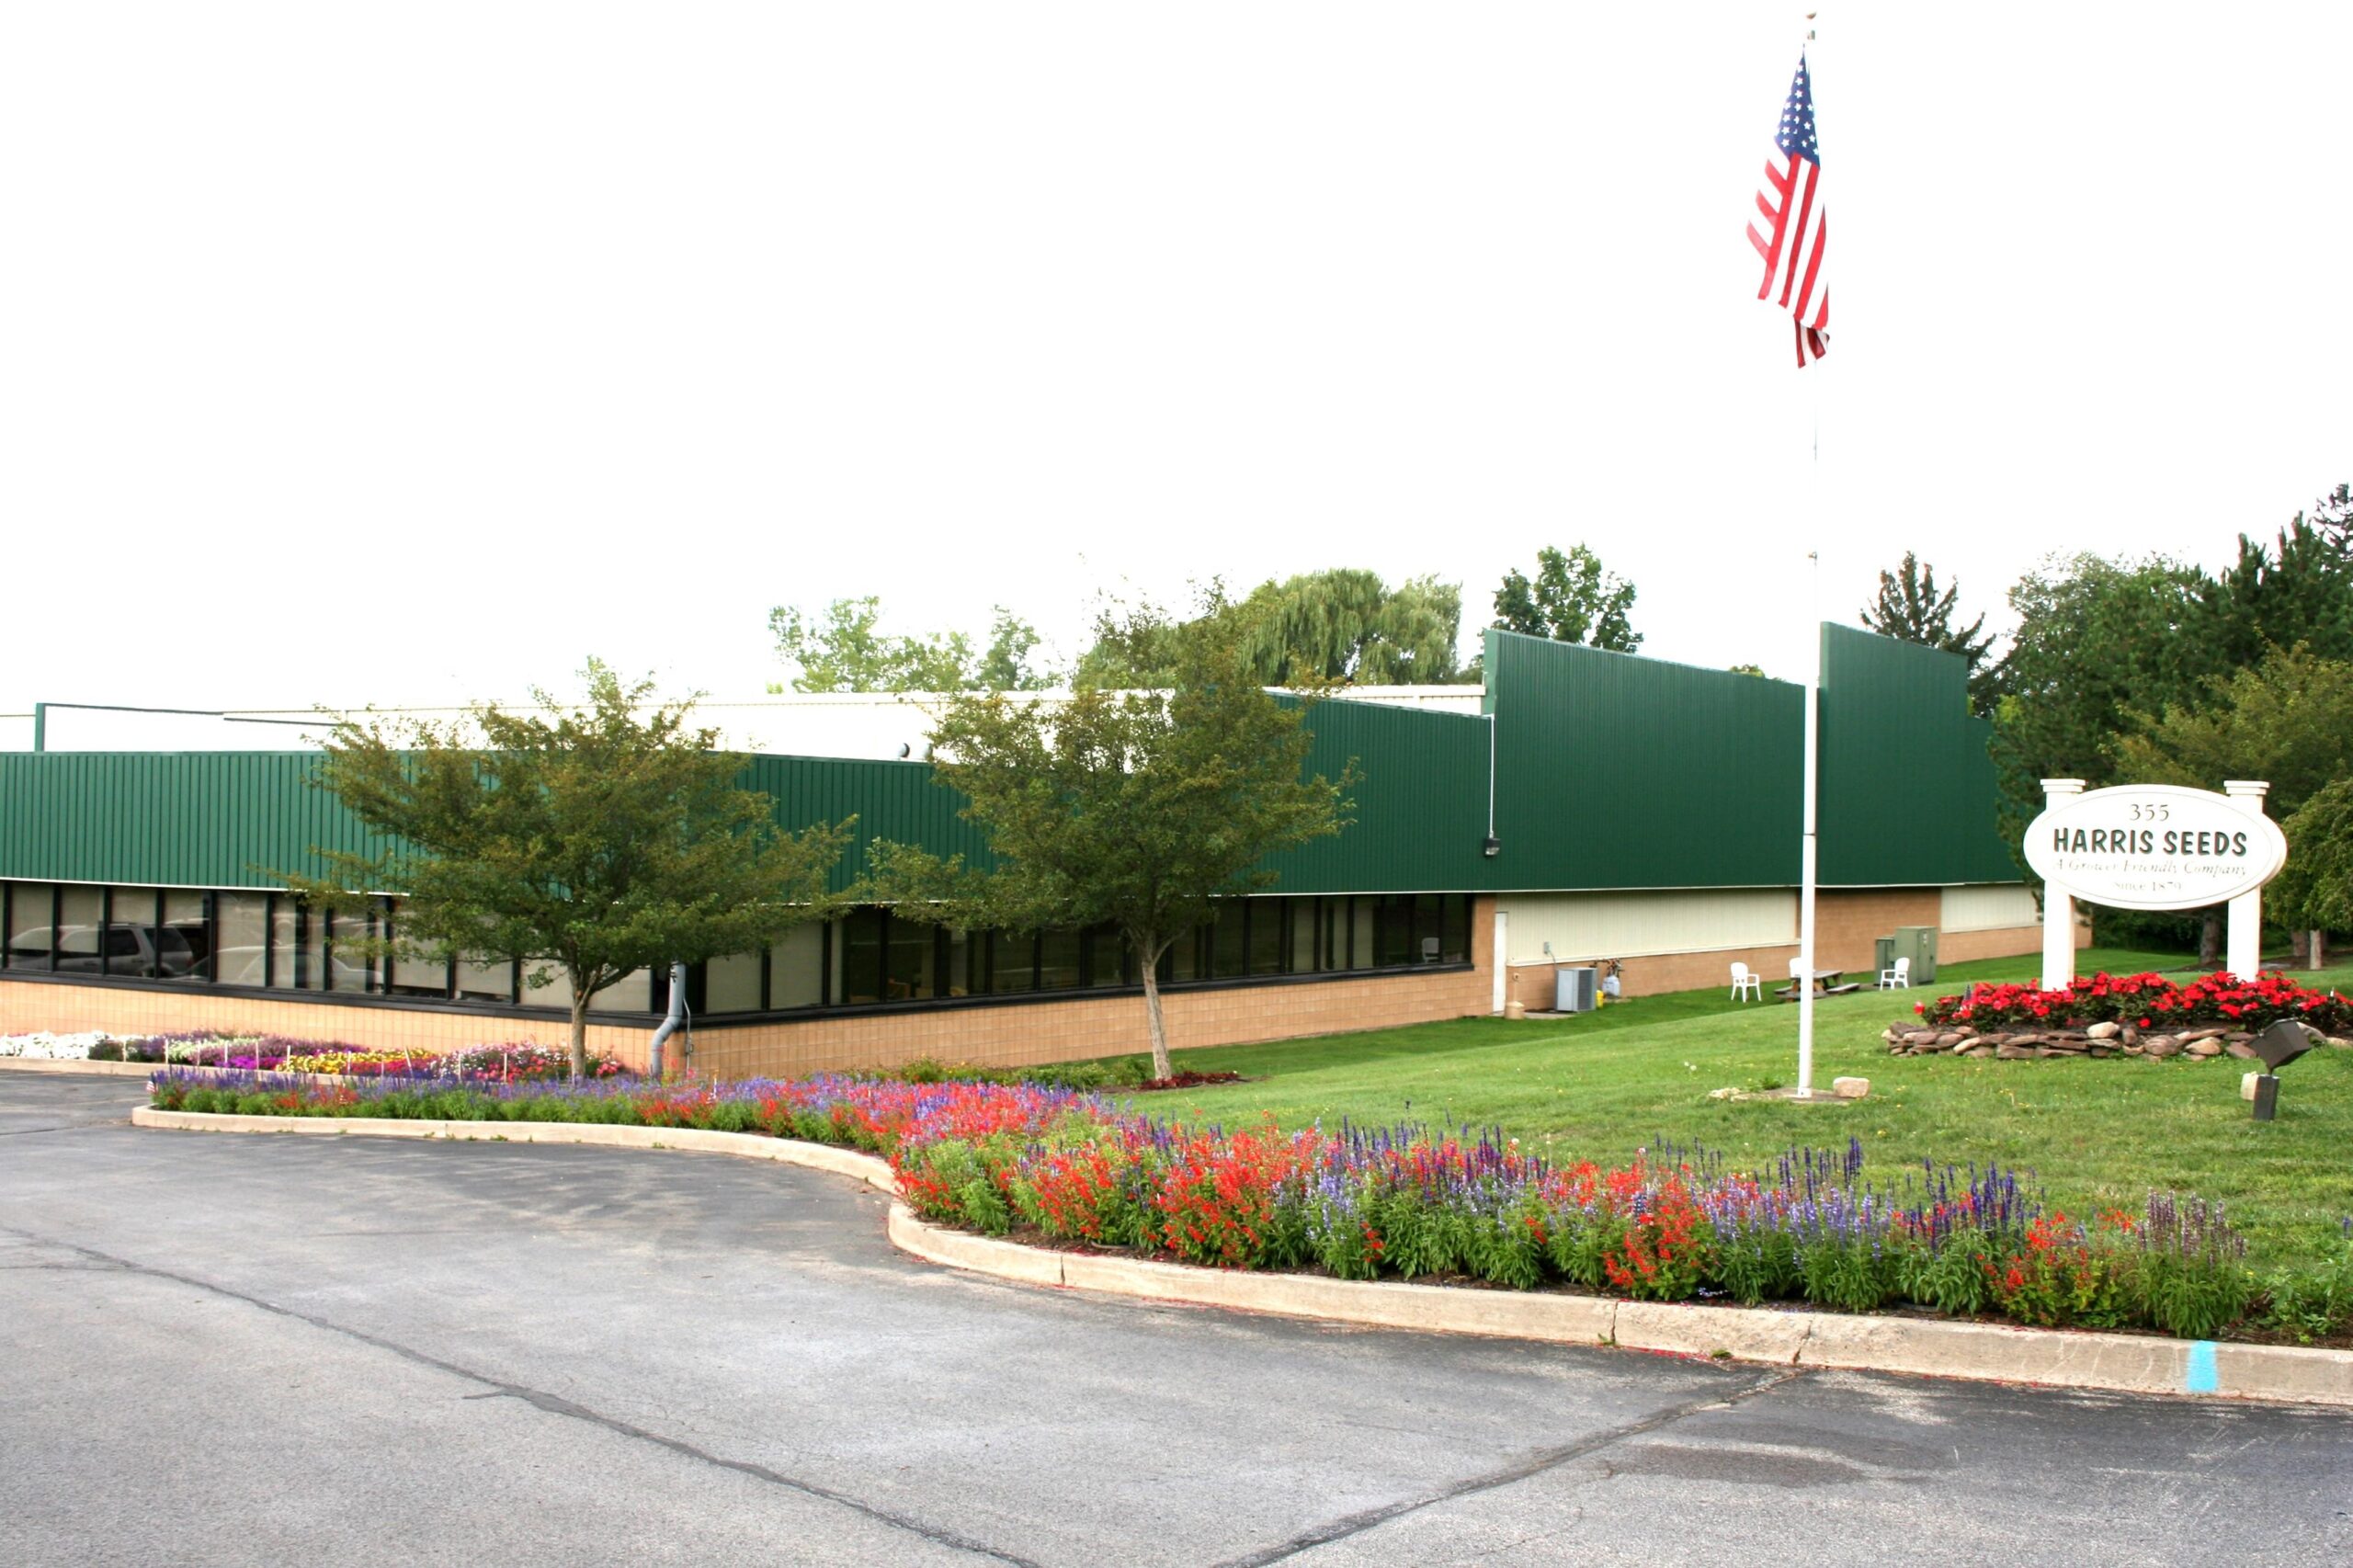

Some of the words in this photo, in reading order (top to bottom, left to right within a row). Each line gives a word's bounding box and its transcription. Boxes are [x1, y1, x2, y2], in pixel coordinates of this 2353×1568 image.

[2129, 803, 2170, 823] 355
[2053, 827, 2154, 855] HARRIS
[2162, 830, 2247, 858] SEEDS
[2122, 859, 2177, 875] Friendly
[2183, 863, 2247, 879] Company
